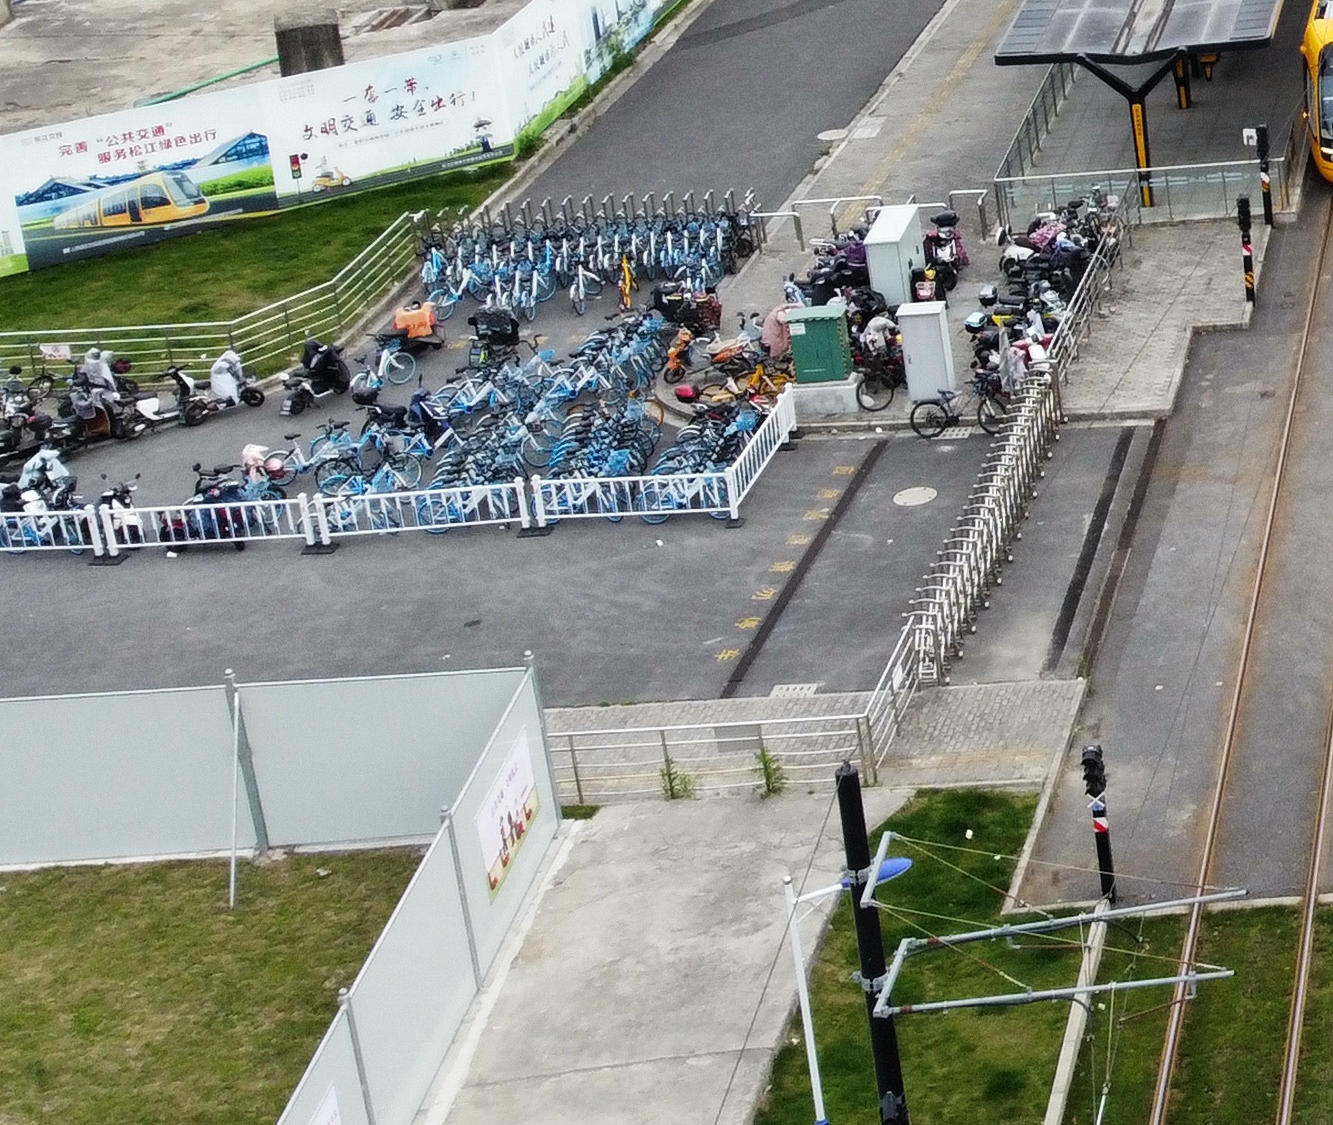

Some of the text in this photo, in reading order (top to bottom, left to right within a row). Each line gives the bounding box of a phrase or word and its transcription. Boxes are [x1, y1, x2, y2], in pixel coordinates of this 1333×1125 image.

[302, 109, 379, 141] 文明交通
[58, 140, 89, 157] 完善
[97, 128, 218, 164] 服务松江绿色出行
